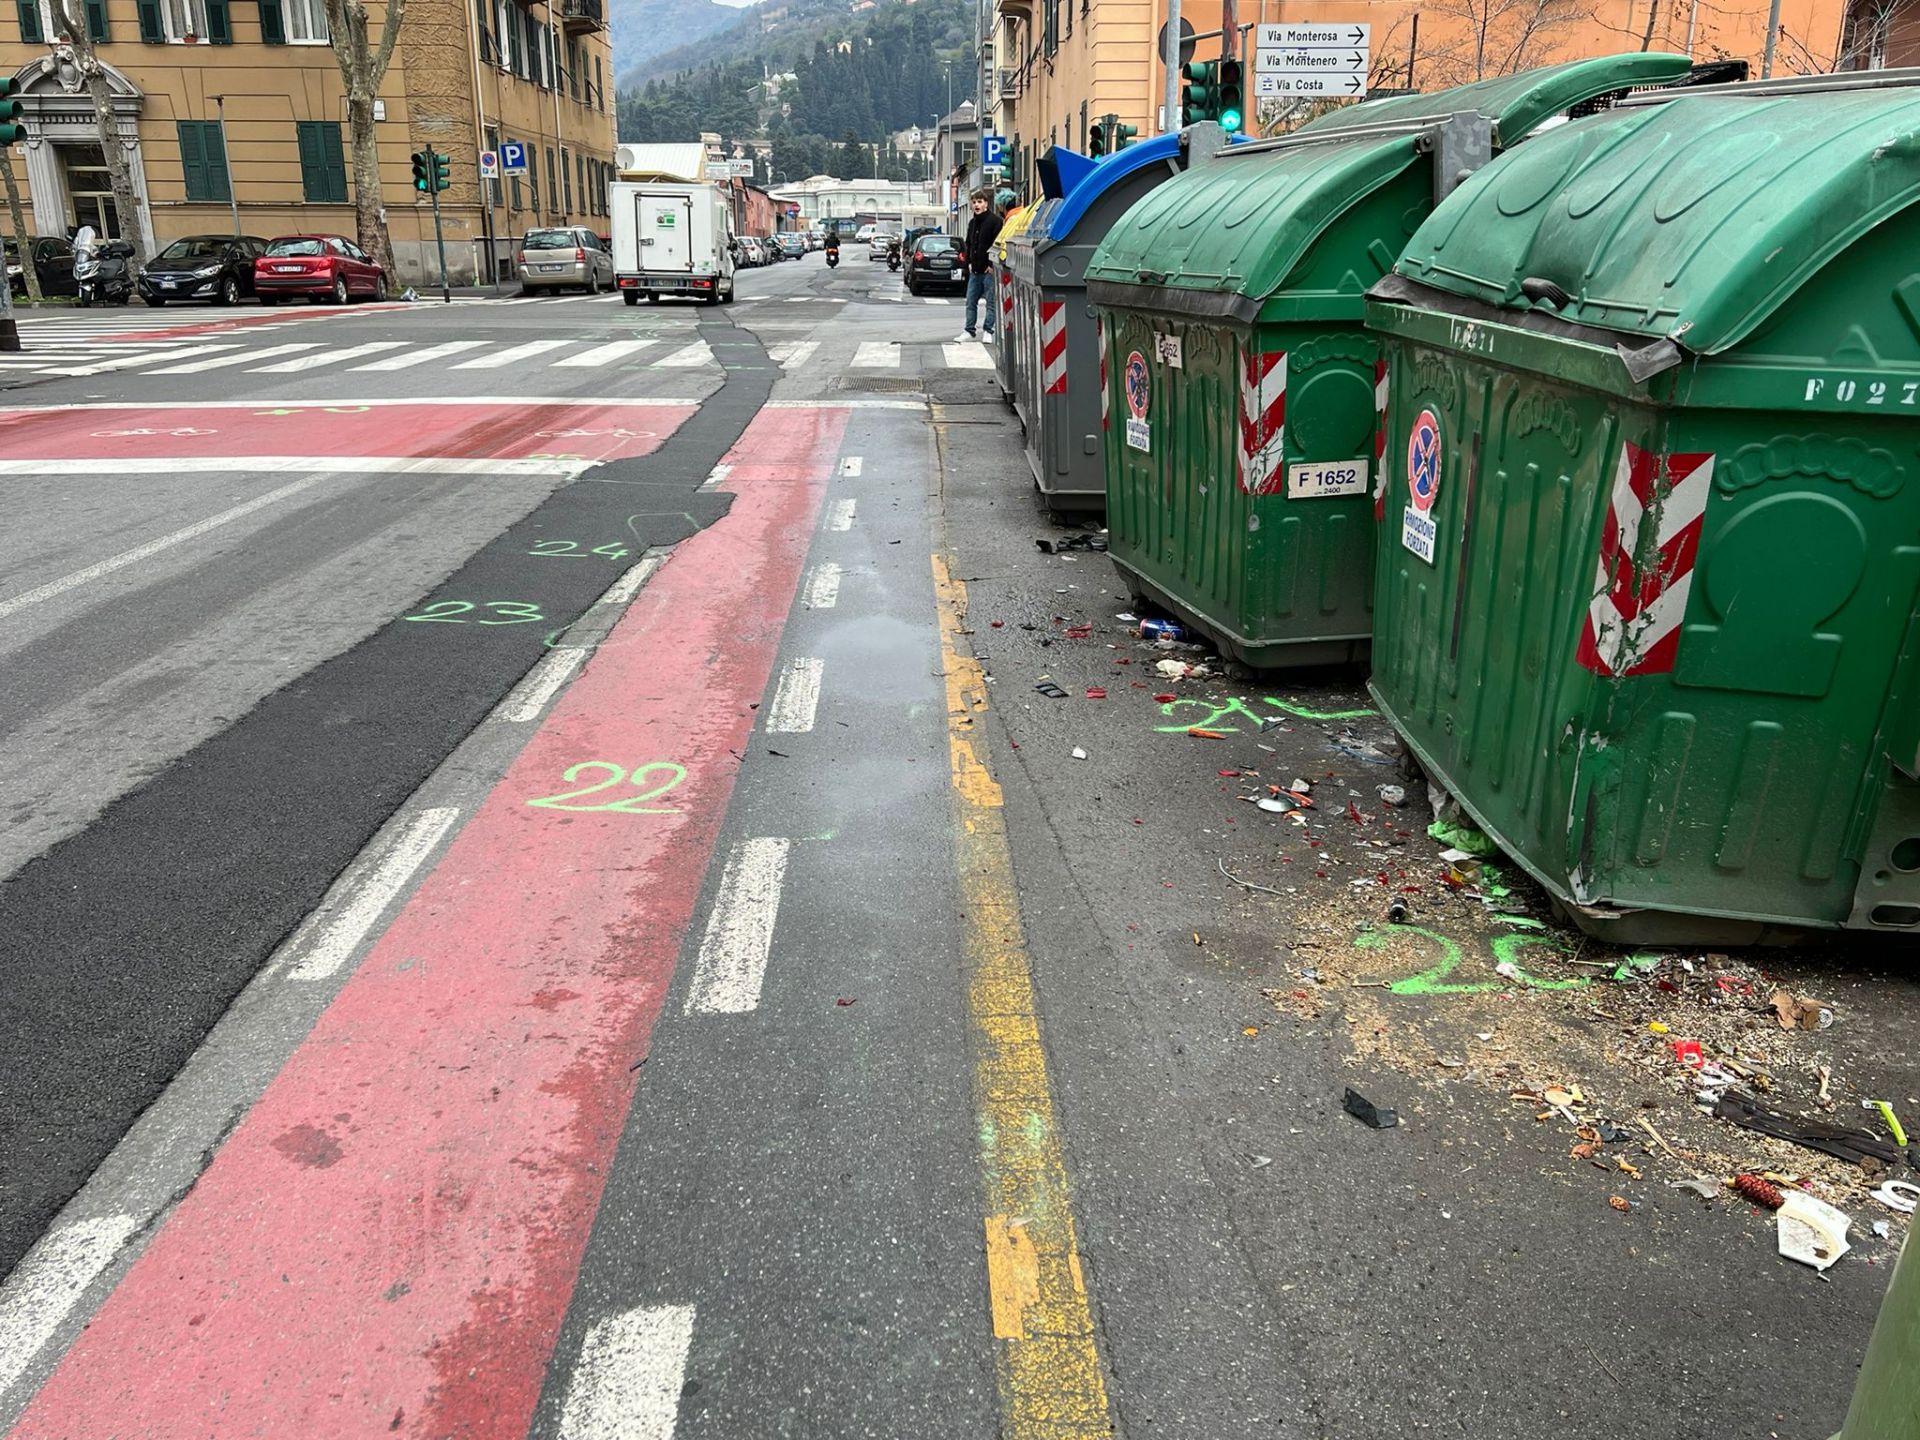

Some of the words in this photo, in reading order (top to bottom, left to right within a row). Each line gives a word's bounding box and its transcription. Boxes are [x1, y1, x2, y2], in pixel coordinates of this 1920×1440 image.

[1267, 30, 1282, 42] Via
[1287, 30, 1338, 42] Monterosa
[1266, 55, 1281, 66] Via
[1286, 55, 1338, 66] Montenero
[1276, 79, 1291, 90] Via
[1295, 79, 1324, 90] Costa
[505, 145, 521, 166] P
[987, 140, 1001, 162] P
[1299, 472, 1310, 487] F
[1315, 468, 1356, 487] 1652
[528, 540, 629, 560] 24
[1406, 530, 1429, 559] FORZATA
[405, 600, 544, 625] 23
[526, 760, 687, 815] 22
